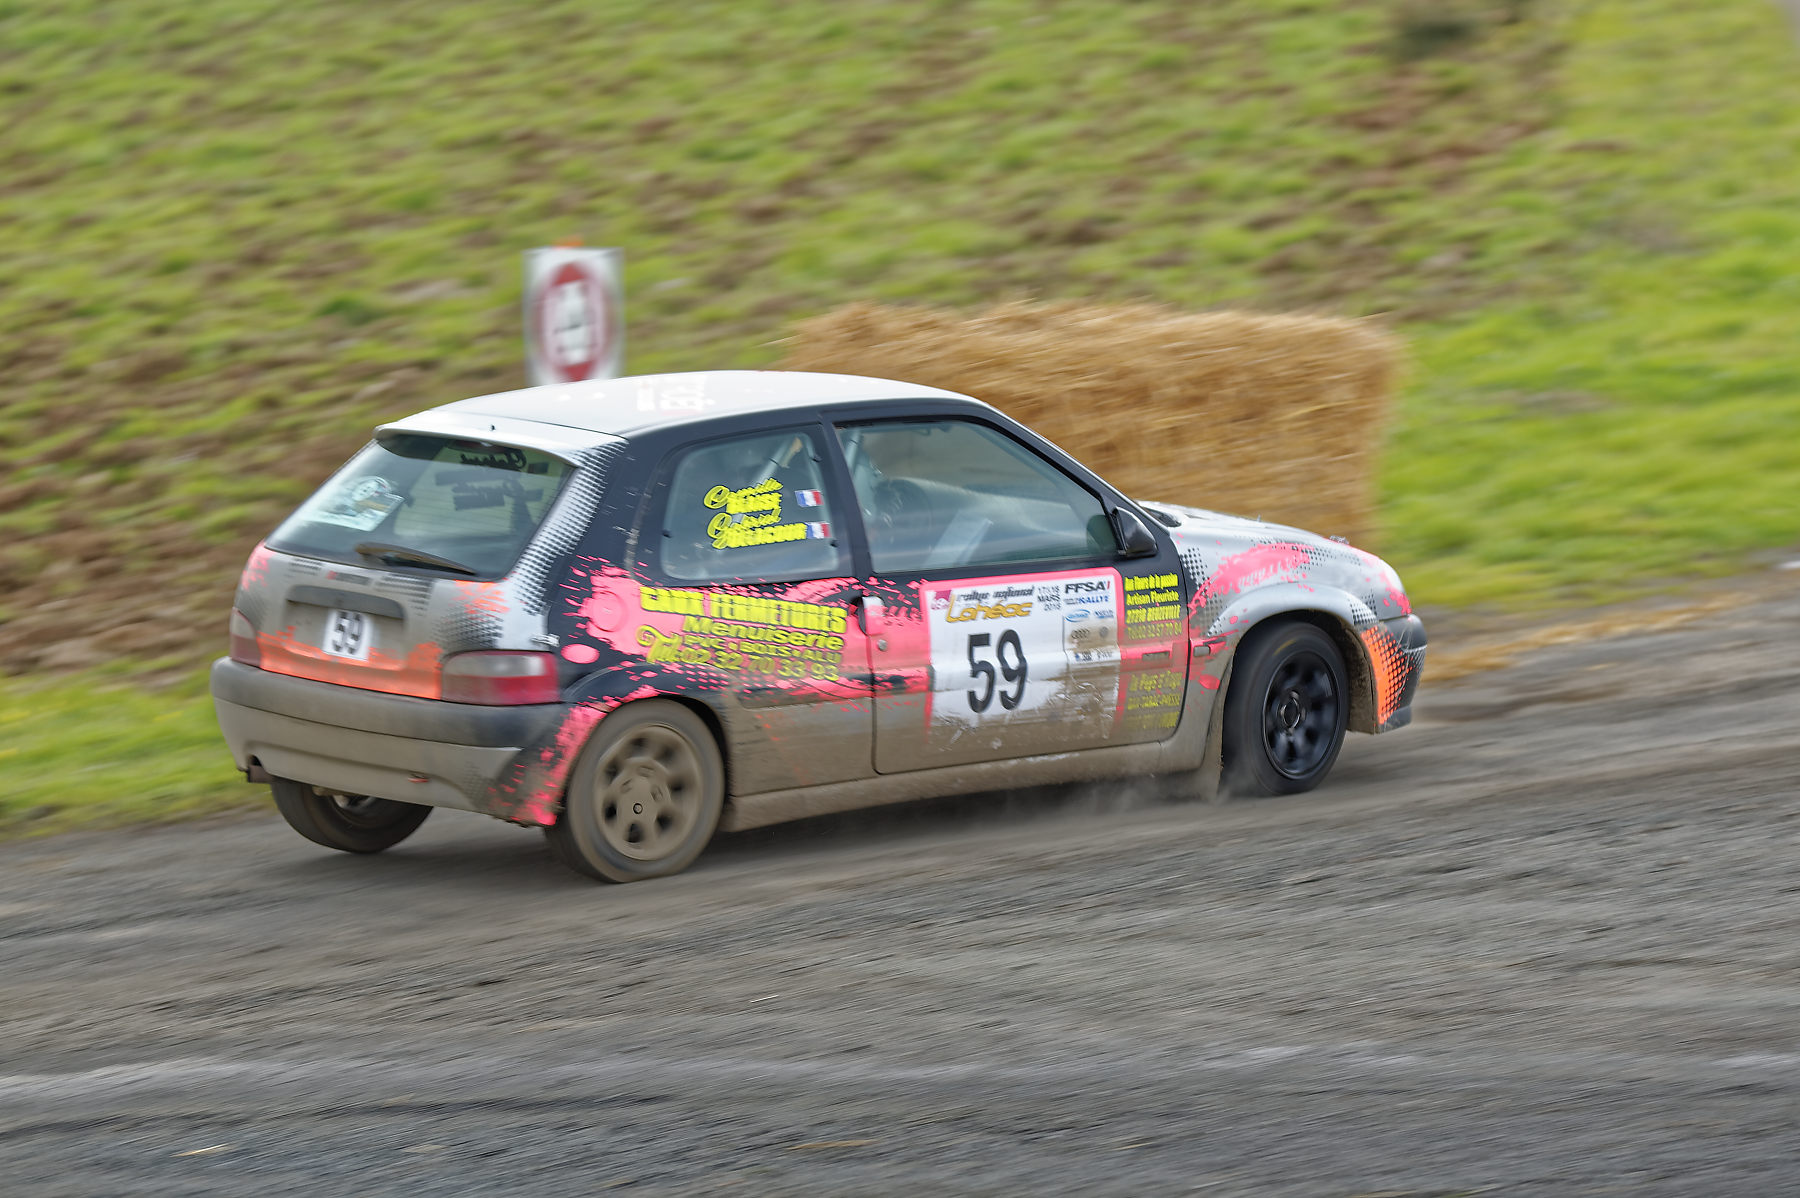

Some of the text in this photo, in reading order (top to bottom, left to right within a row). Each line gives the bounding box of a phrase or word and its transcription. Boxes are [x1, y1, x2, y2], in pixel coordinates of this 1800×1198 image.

[1065, 580, 1106, 594] FFSA
[1126, 589, 1179, 606] Artisan Fleuriste
[945, 593, 1034, 623] Lohéac
[332, 610, 362, 655] 59
[682, 615, 845, 651] Menuiserie
[713, 650, 744, 671] 32
[777, 659, 807, 678] 33
[967, 629, 1027, 713] 59
